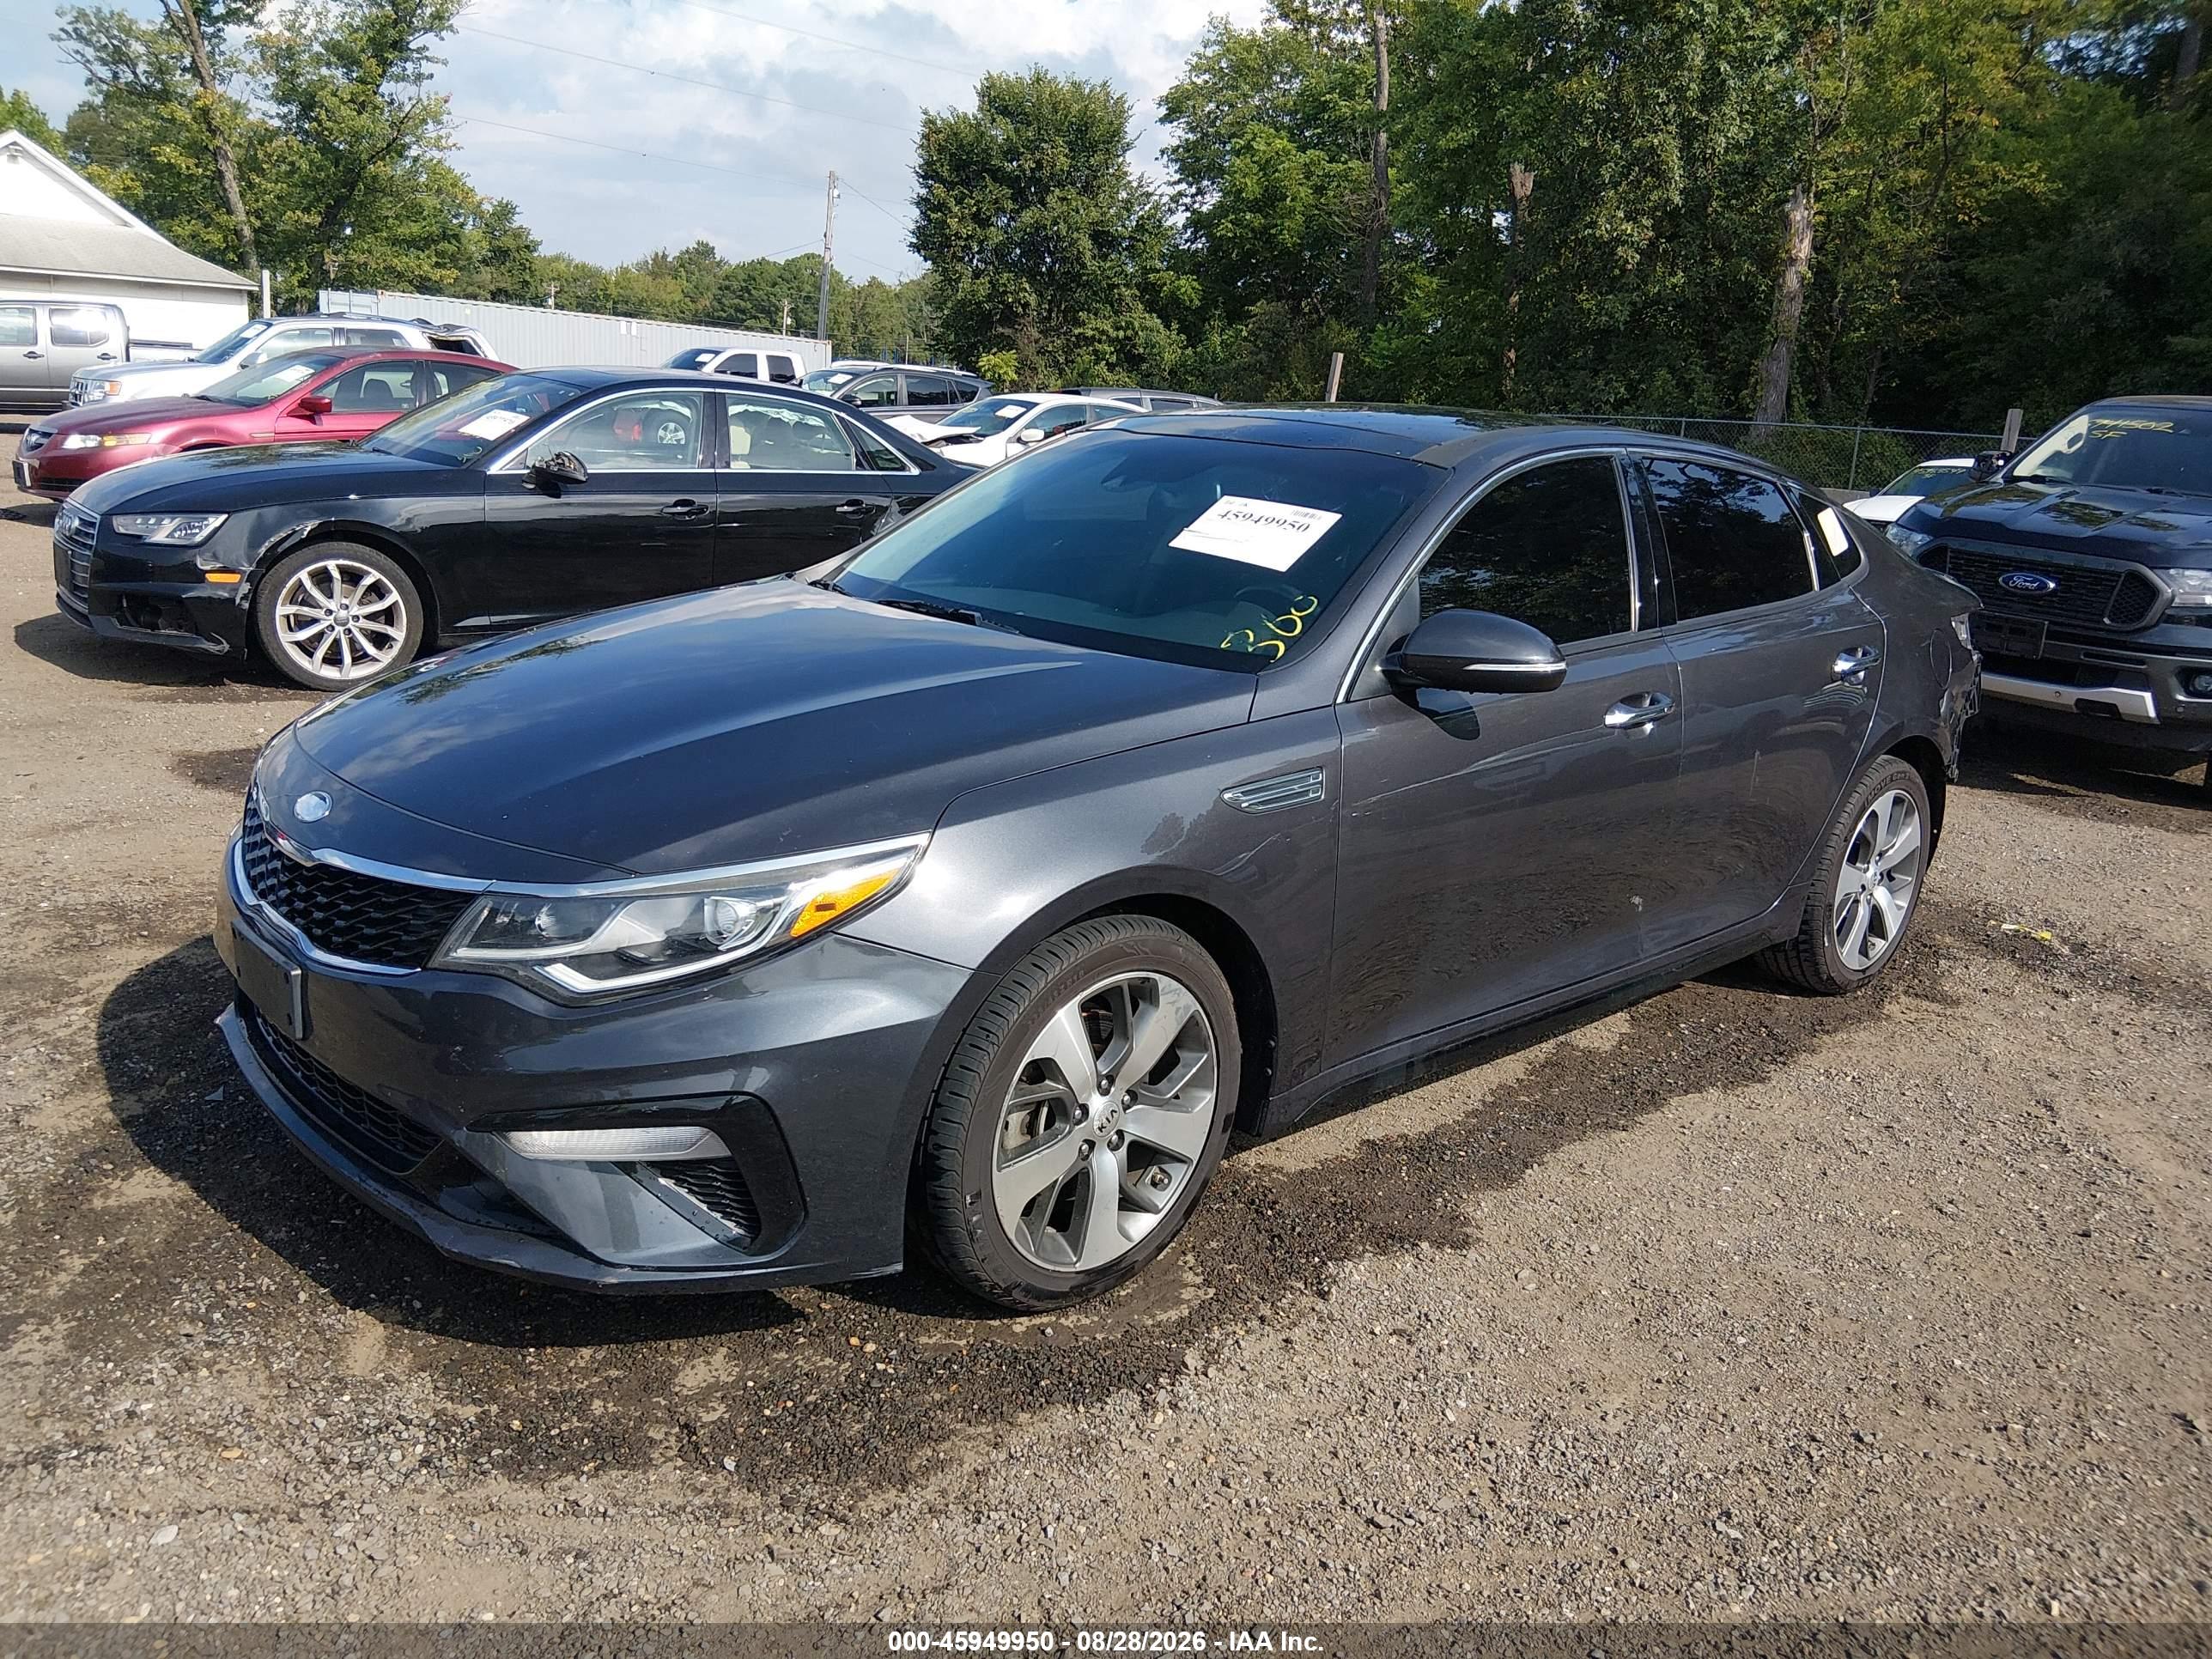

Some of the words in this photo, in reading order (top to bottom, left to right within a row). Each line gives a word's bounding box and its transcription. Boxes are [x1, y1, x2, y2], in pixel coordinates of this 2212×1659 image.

[1218, 509, 1310, 532] 45949950
[2009, 575, 2040, 590] Ford
[1097, 1109, 1118, 1133] KIA
